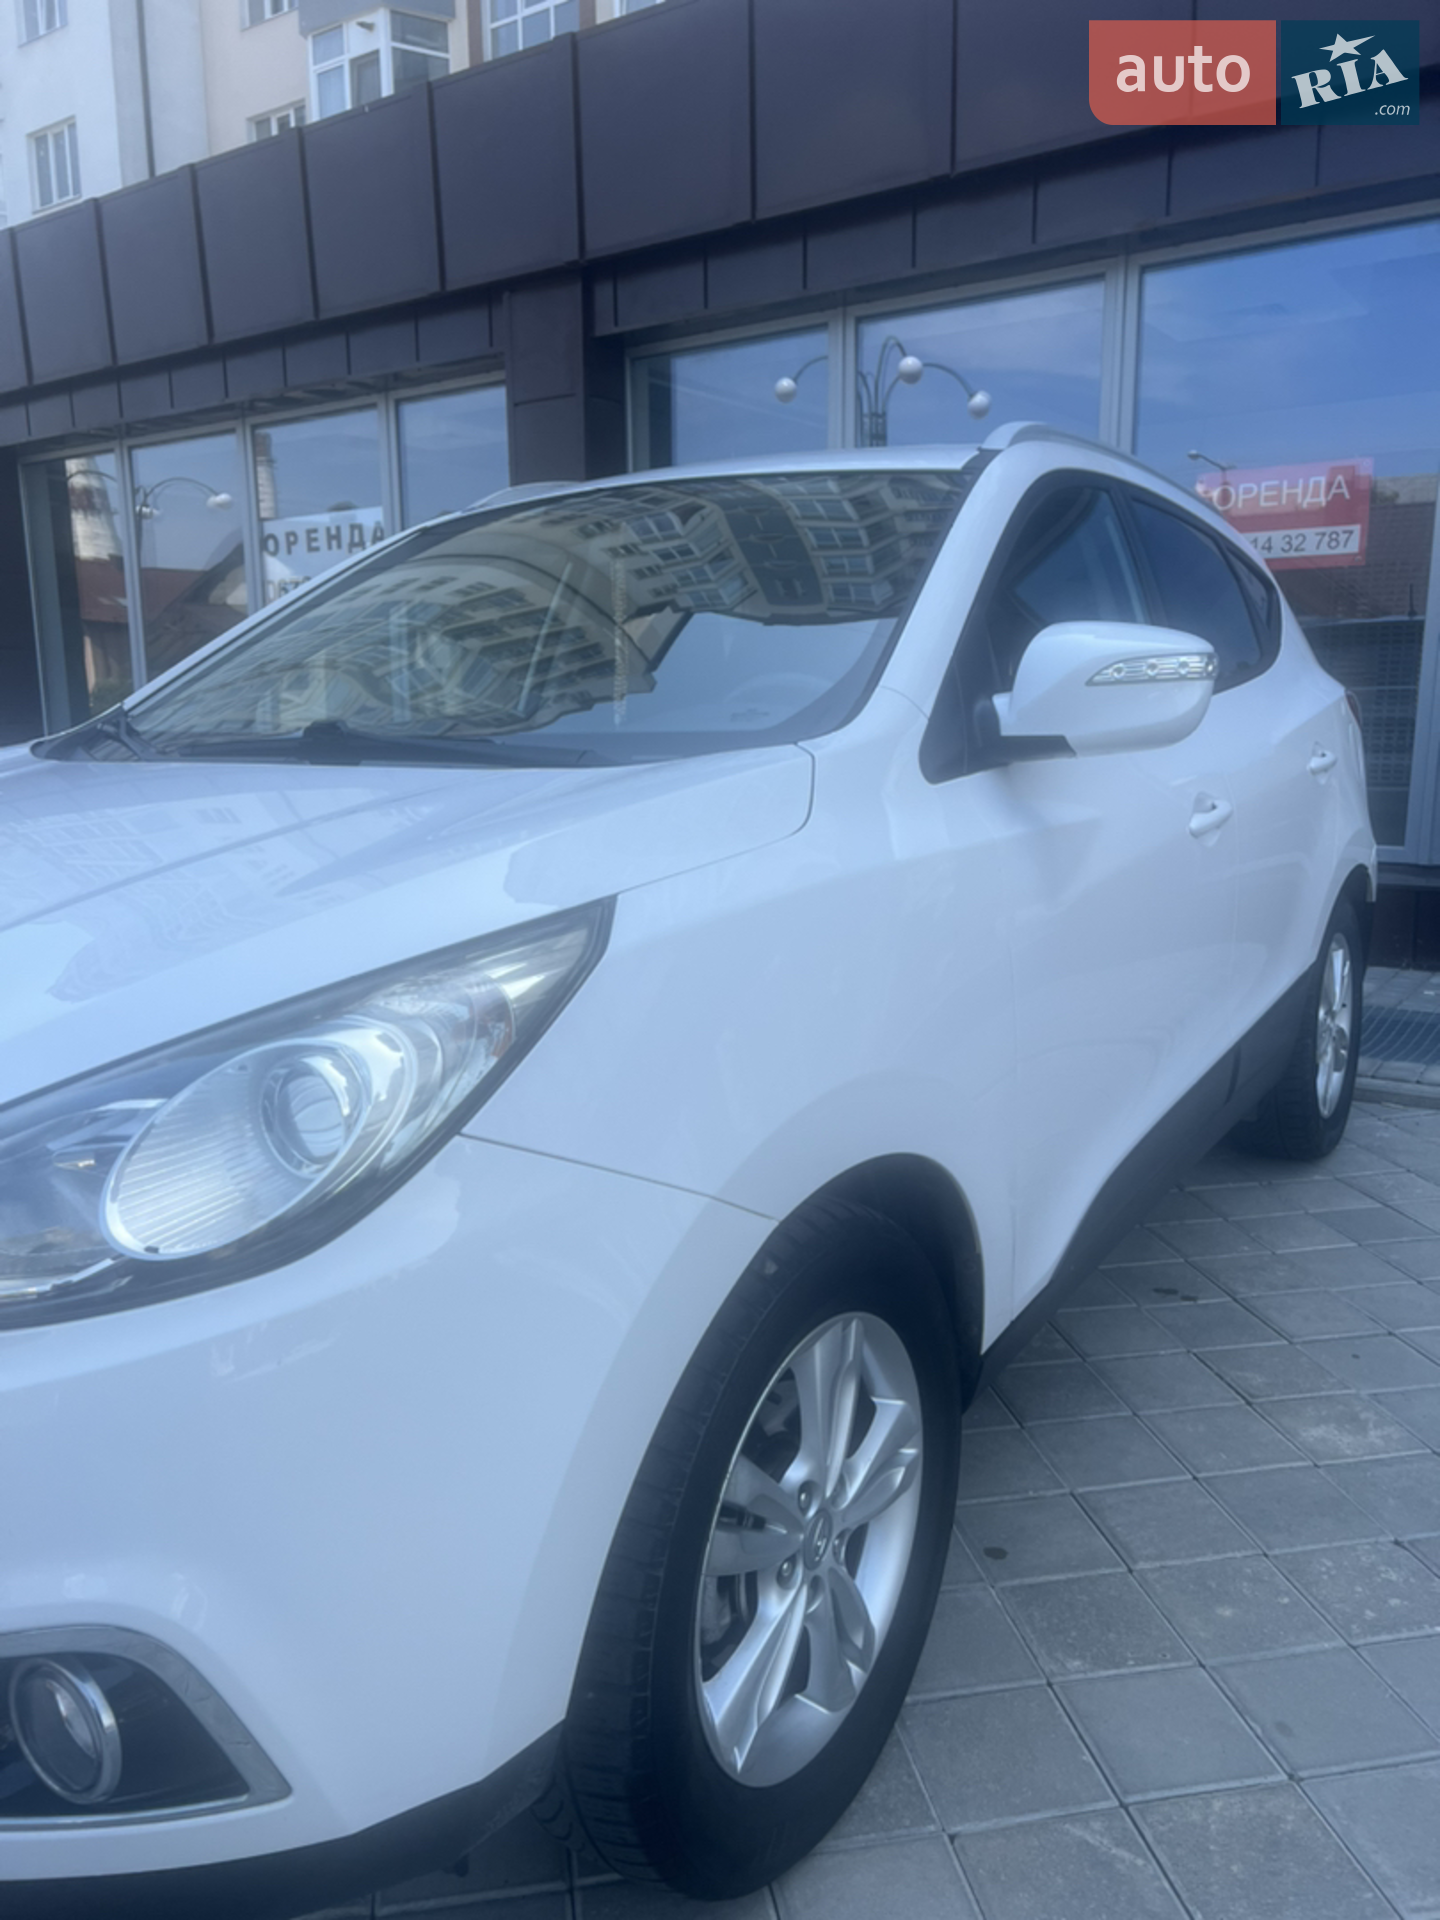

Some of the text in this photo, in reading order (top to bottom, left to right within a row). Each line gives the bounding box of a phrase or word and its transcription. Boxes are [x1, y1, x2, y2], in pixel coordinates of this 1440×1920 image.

[1212, 475, 1350, 511] ОРЕНДА
[262, 521, 384, 557] ОРЕНДА
[1281, 533, 1307, 553] 32
[1315, 529, 1354, 550] 787
